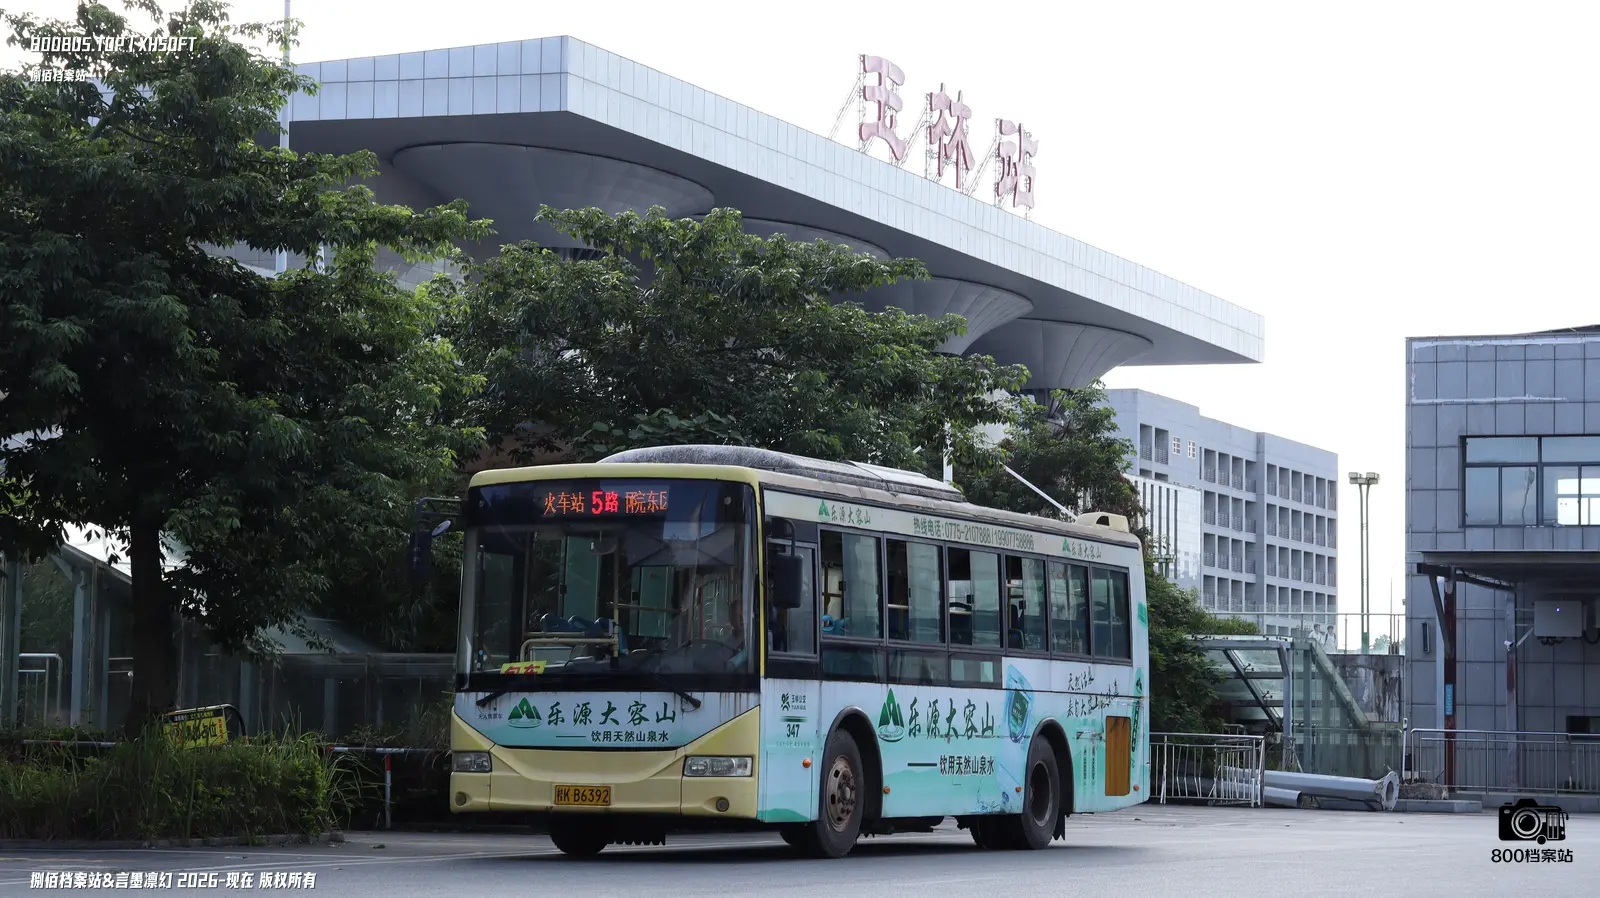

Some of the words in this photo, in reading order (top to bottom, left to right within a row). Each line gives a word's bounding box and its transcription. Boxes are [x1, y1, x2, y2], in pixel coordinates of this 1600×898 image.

[859, 53, 1040, 209] 玉林站
[543, 491, 585, 516] 火车站
[591, 490, 619, 515] 5路
[547, 700, 677, 727] 乐源大容山
[908, 696, 995, 741] 乐源大容山
[590, 730, 669, 743] 饮用天然山泉水
[786, 723, 800, 738] 347
[939, 754, 995, 776] 饮用天然山泉水
